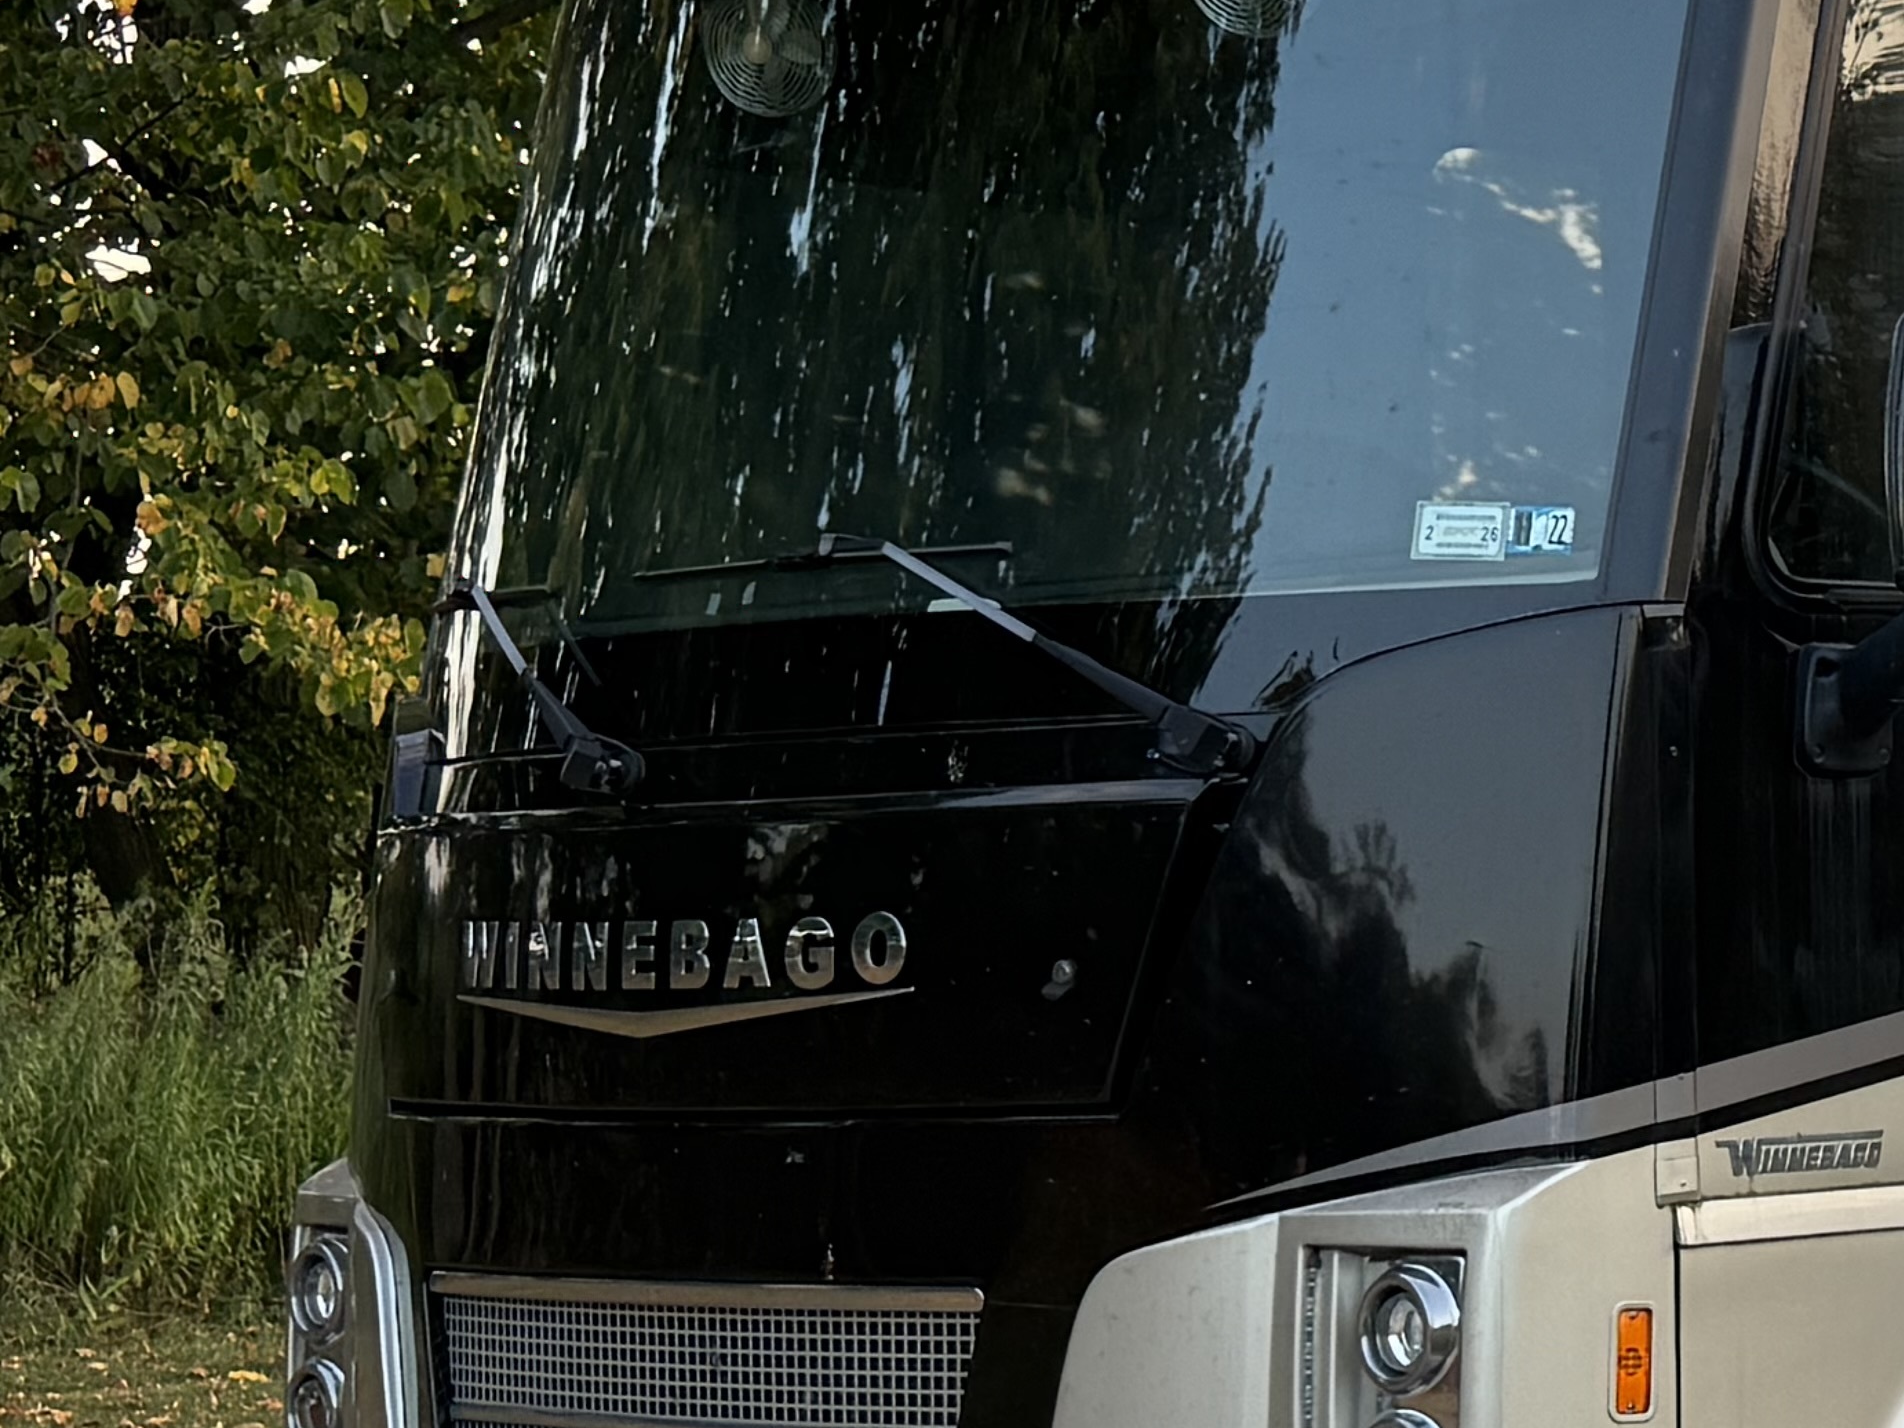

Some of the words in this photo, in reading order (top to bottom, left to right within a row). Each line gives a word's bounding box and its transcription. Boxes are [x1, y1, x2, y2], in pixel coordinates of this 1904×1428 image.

[1424, 525, 1434, 541] 2
[1548, 514, 1571, 545] 22
[461, 910, 907, 991] WINNEBAGO
[1715, 1129, 1884, 1177] WINNEBAGO
